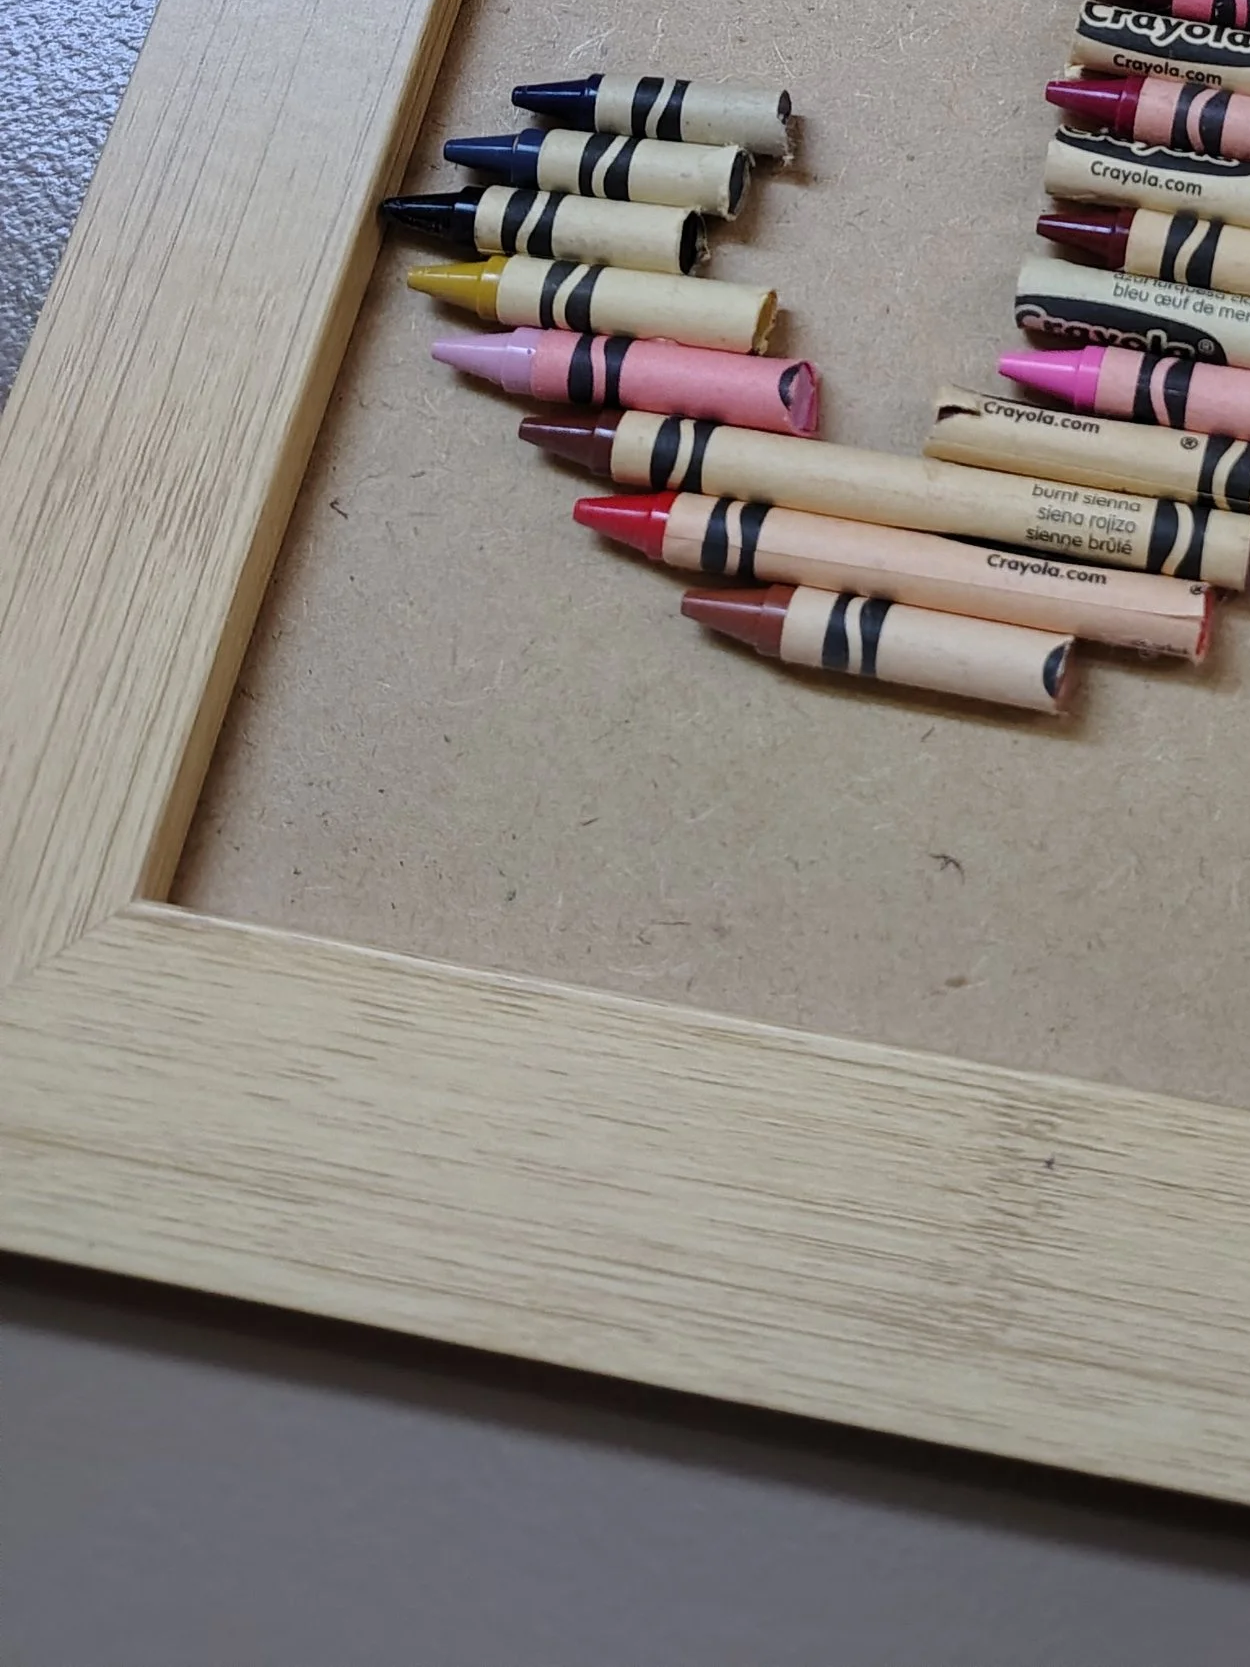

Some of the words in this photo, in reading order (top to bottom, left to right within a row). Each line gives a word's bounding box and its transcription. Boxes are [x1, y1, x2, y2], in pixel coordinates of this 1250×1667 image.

[1112, 53, 1223, 87] Crayola.com
[1089, 160, 1203, 197] Crayola.com
[1112, 281, 1150, 303] bleu
[1192, 298, 1215, 316] de
[983, 399, 1101, 435] Crayola.com
[1031, 483, 1081, 503] burnt
[1082, 493, 1143, 514] sienna
[1035, 504, 1086, 527] siena
[1087, 512, 1138, 535] rojizo
[1024, 525, 1084, 549] sienne
[1086, 533, 1134, 556] brûlé
[985, 552, 1108, 586] Crayola.com
